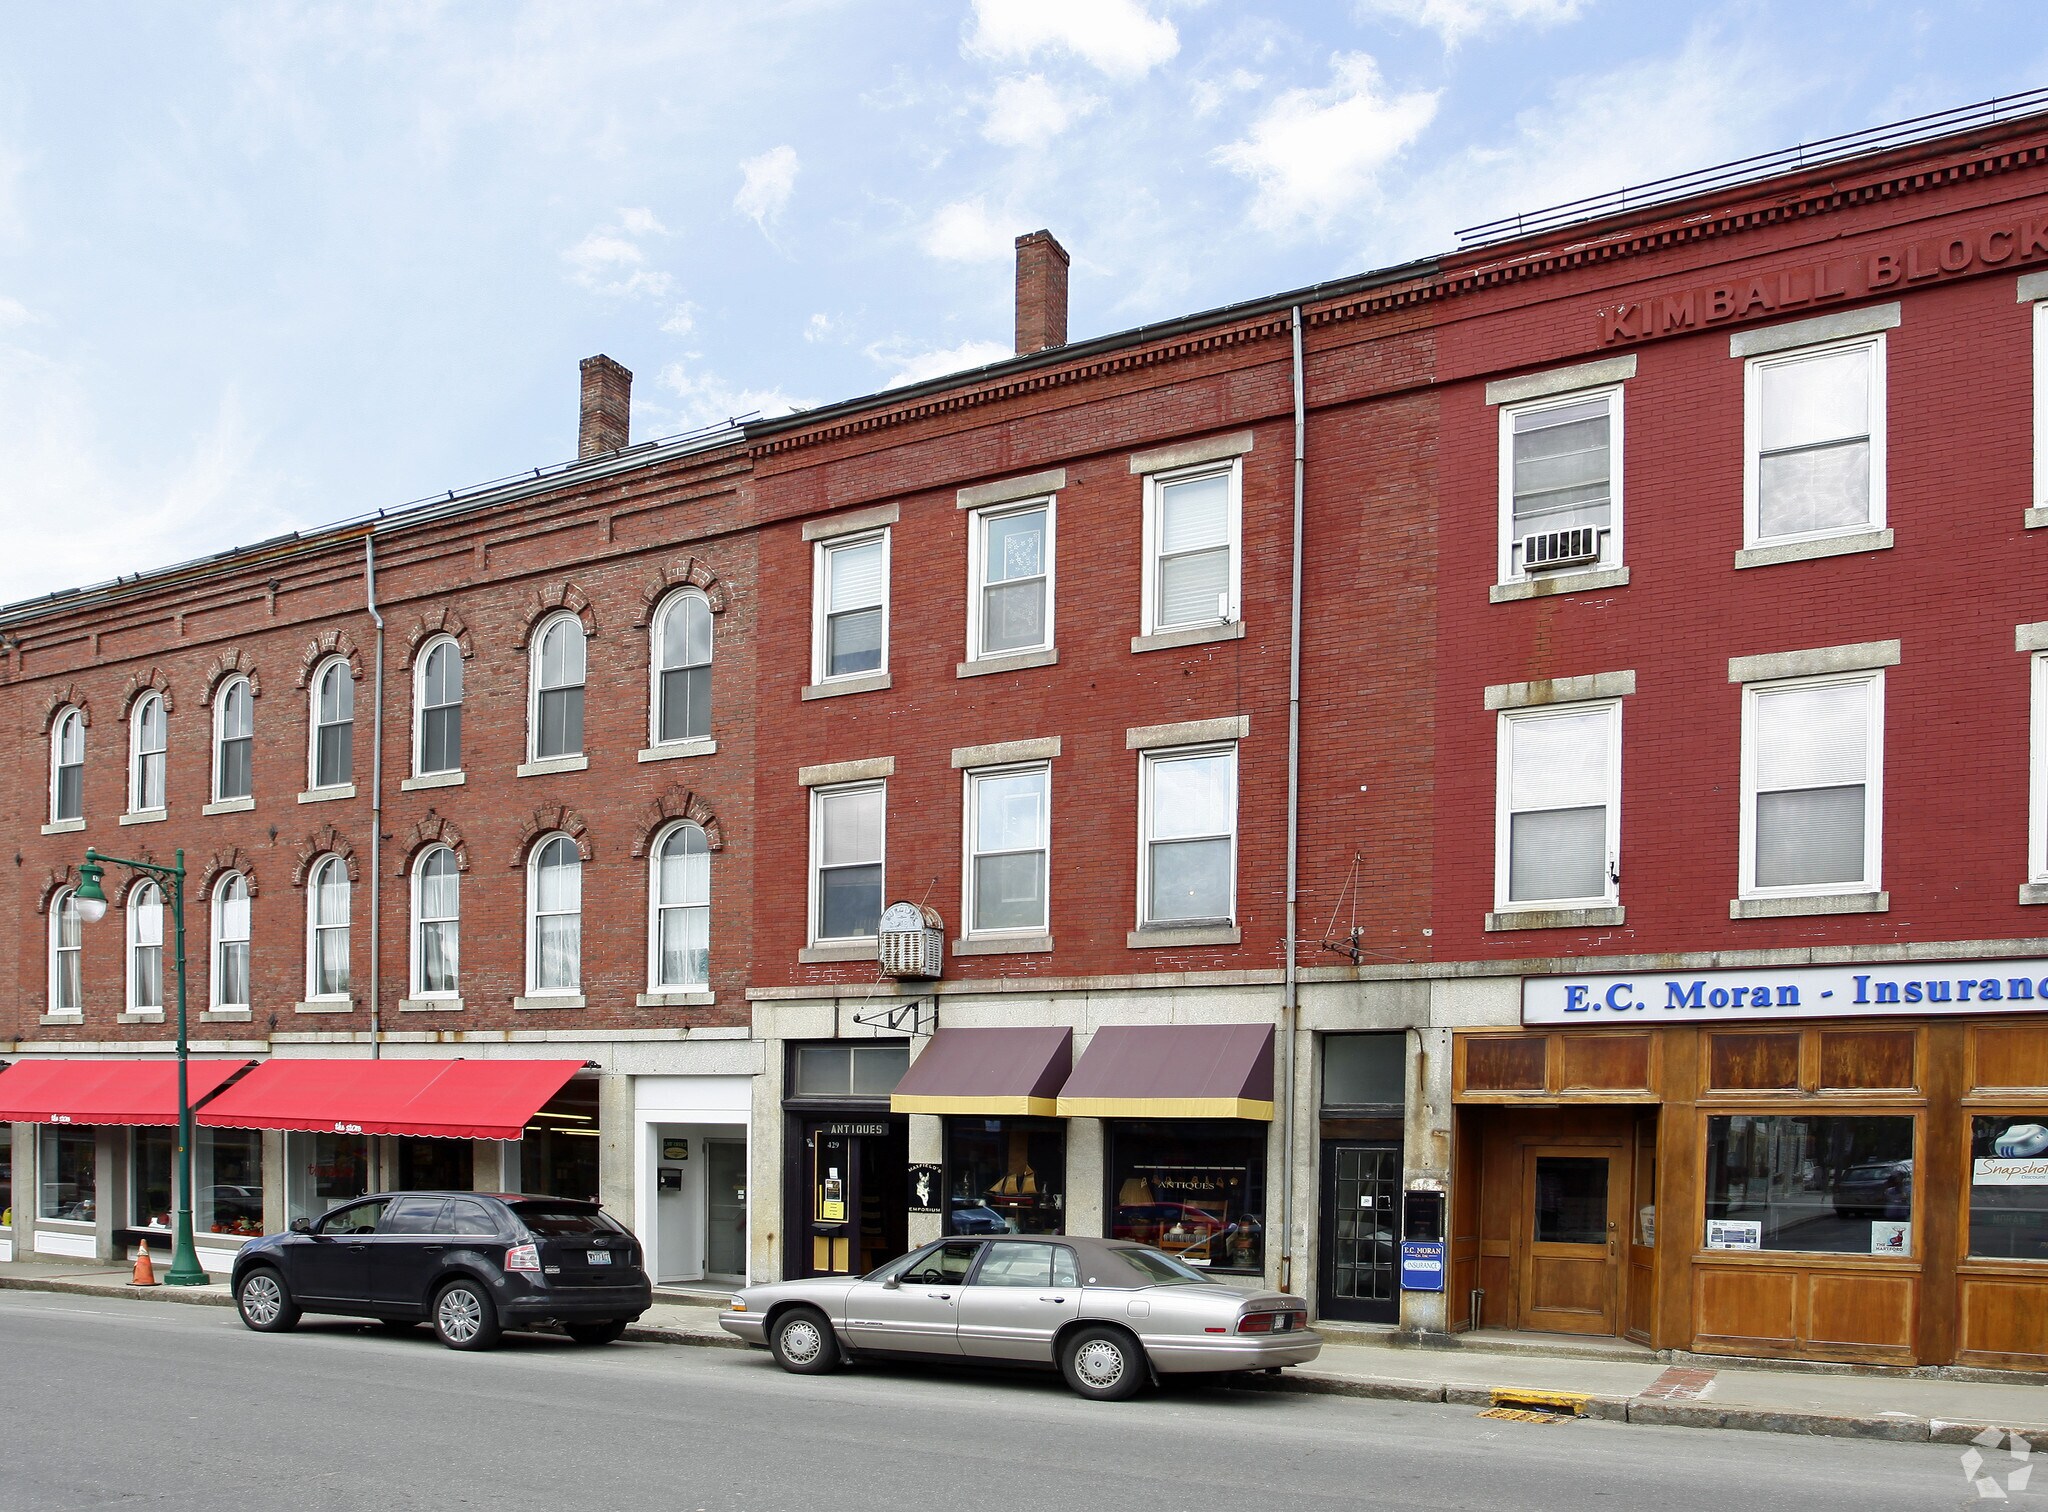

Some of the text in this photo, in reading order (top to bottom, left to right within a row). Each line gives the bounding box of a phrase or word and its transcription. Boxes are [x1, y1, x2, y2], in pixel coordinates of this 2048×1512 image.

[1605, 219, 2048, 343] KIMBALL BLOCK
[1564, 983, 1645, 1012] E.C.
[1664, 981, 1801, 1009] Moran
[830, 1124, 883, 1135] ANTIQUES
[827, 1141, 840, 1149] 429
[1158, 1181, 1215, 1190] ANTIQUES
[1416, 1247, 1441, 1255] MORAN
[1407, 1261, 1438, 1269] INSURANCE
